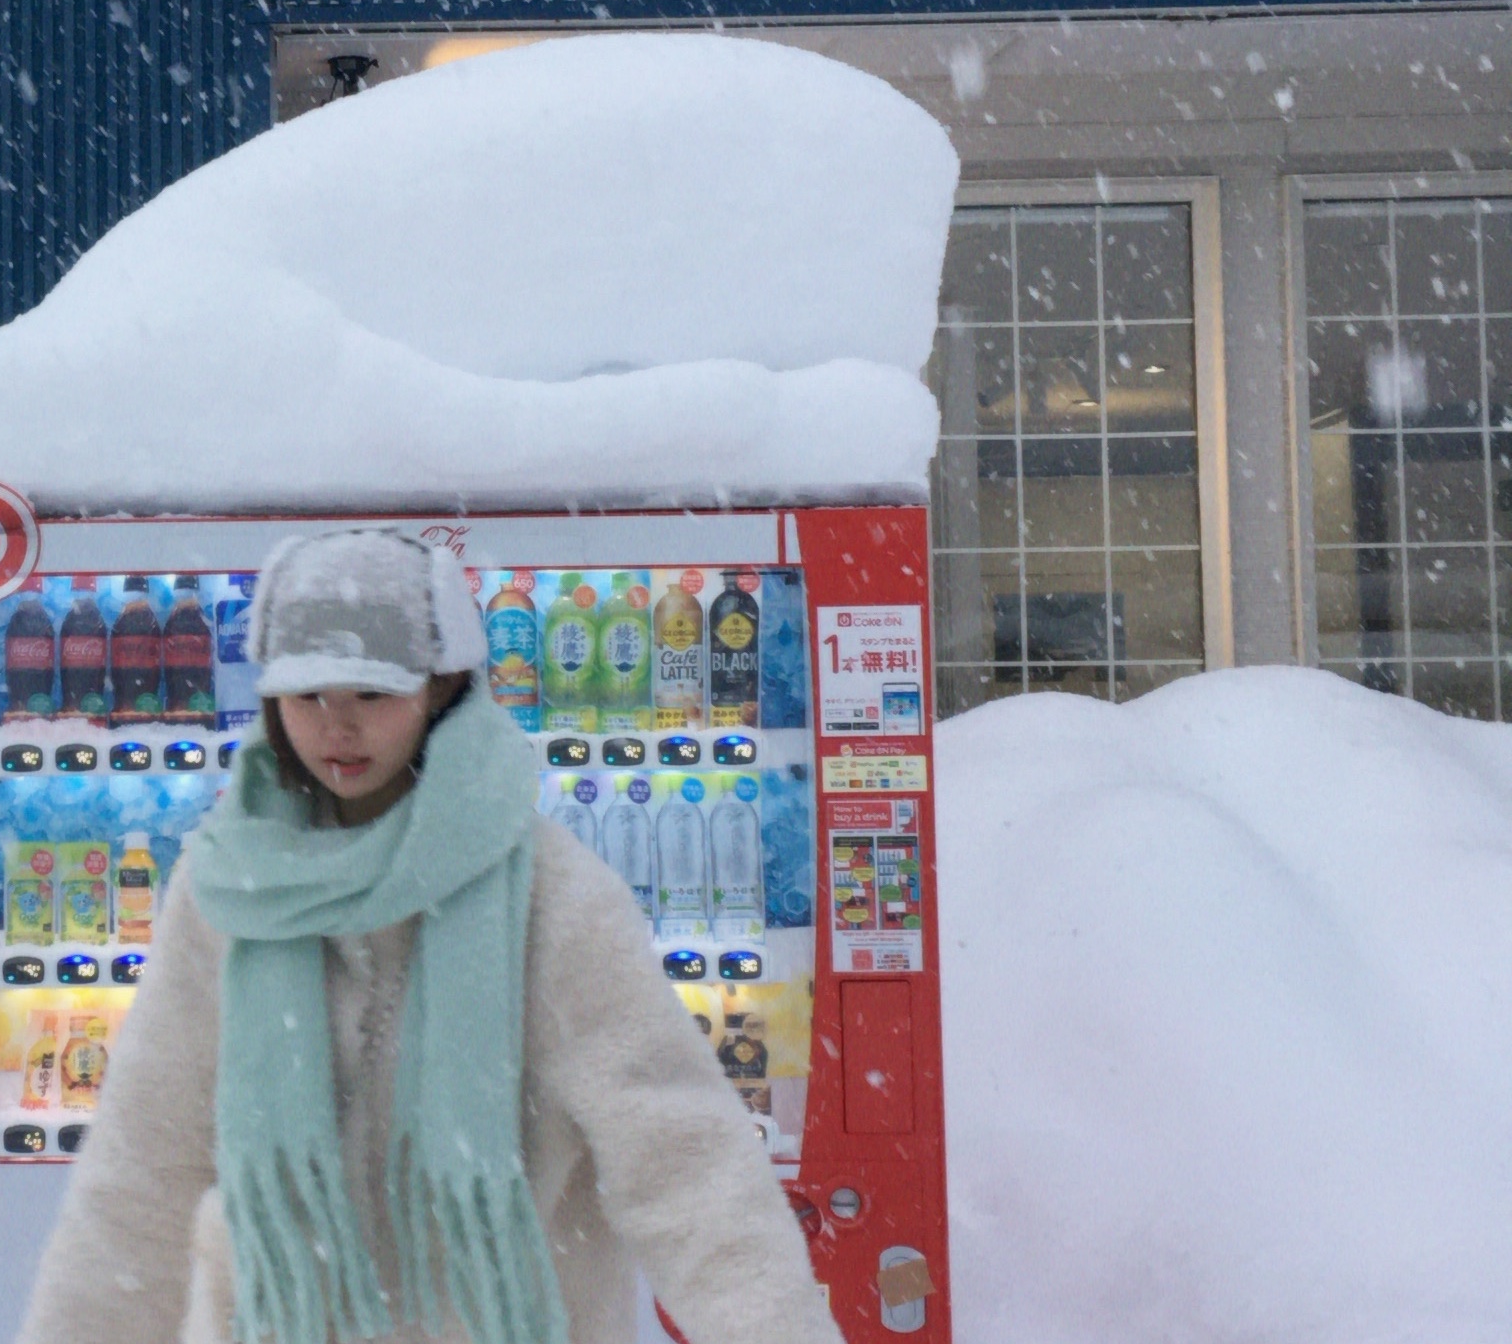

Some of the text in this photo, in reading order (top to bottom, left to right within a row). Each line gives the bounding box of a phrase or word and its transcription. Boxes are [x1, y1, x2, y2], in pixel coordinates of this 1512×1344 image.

[419, 525, 472, 560] Cla
[513, 577, 533, 589] 650
[853, 617, 882, 627] Coke
[490, 625, 535, 649] 麦茶
[561, 622, 581, 661] 綾鷹
[615, 622, 634, 661] 綾鷹
[860, 637, 916, 646] スタンプたまると
[660, 649, 698, 665] Café
[712, 652, 758, 671] BLACK
[661, 665, 698, 680] LATTE
[890, 746, 906, 755] Pay
[833, 813, 852, 823] buy
[862, 812, 888, 821] drink
